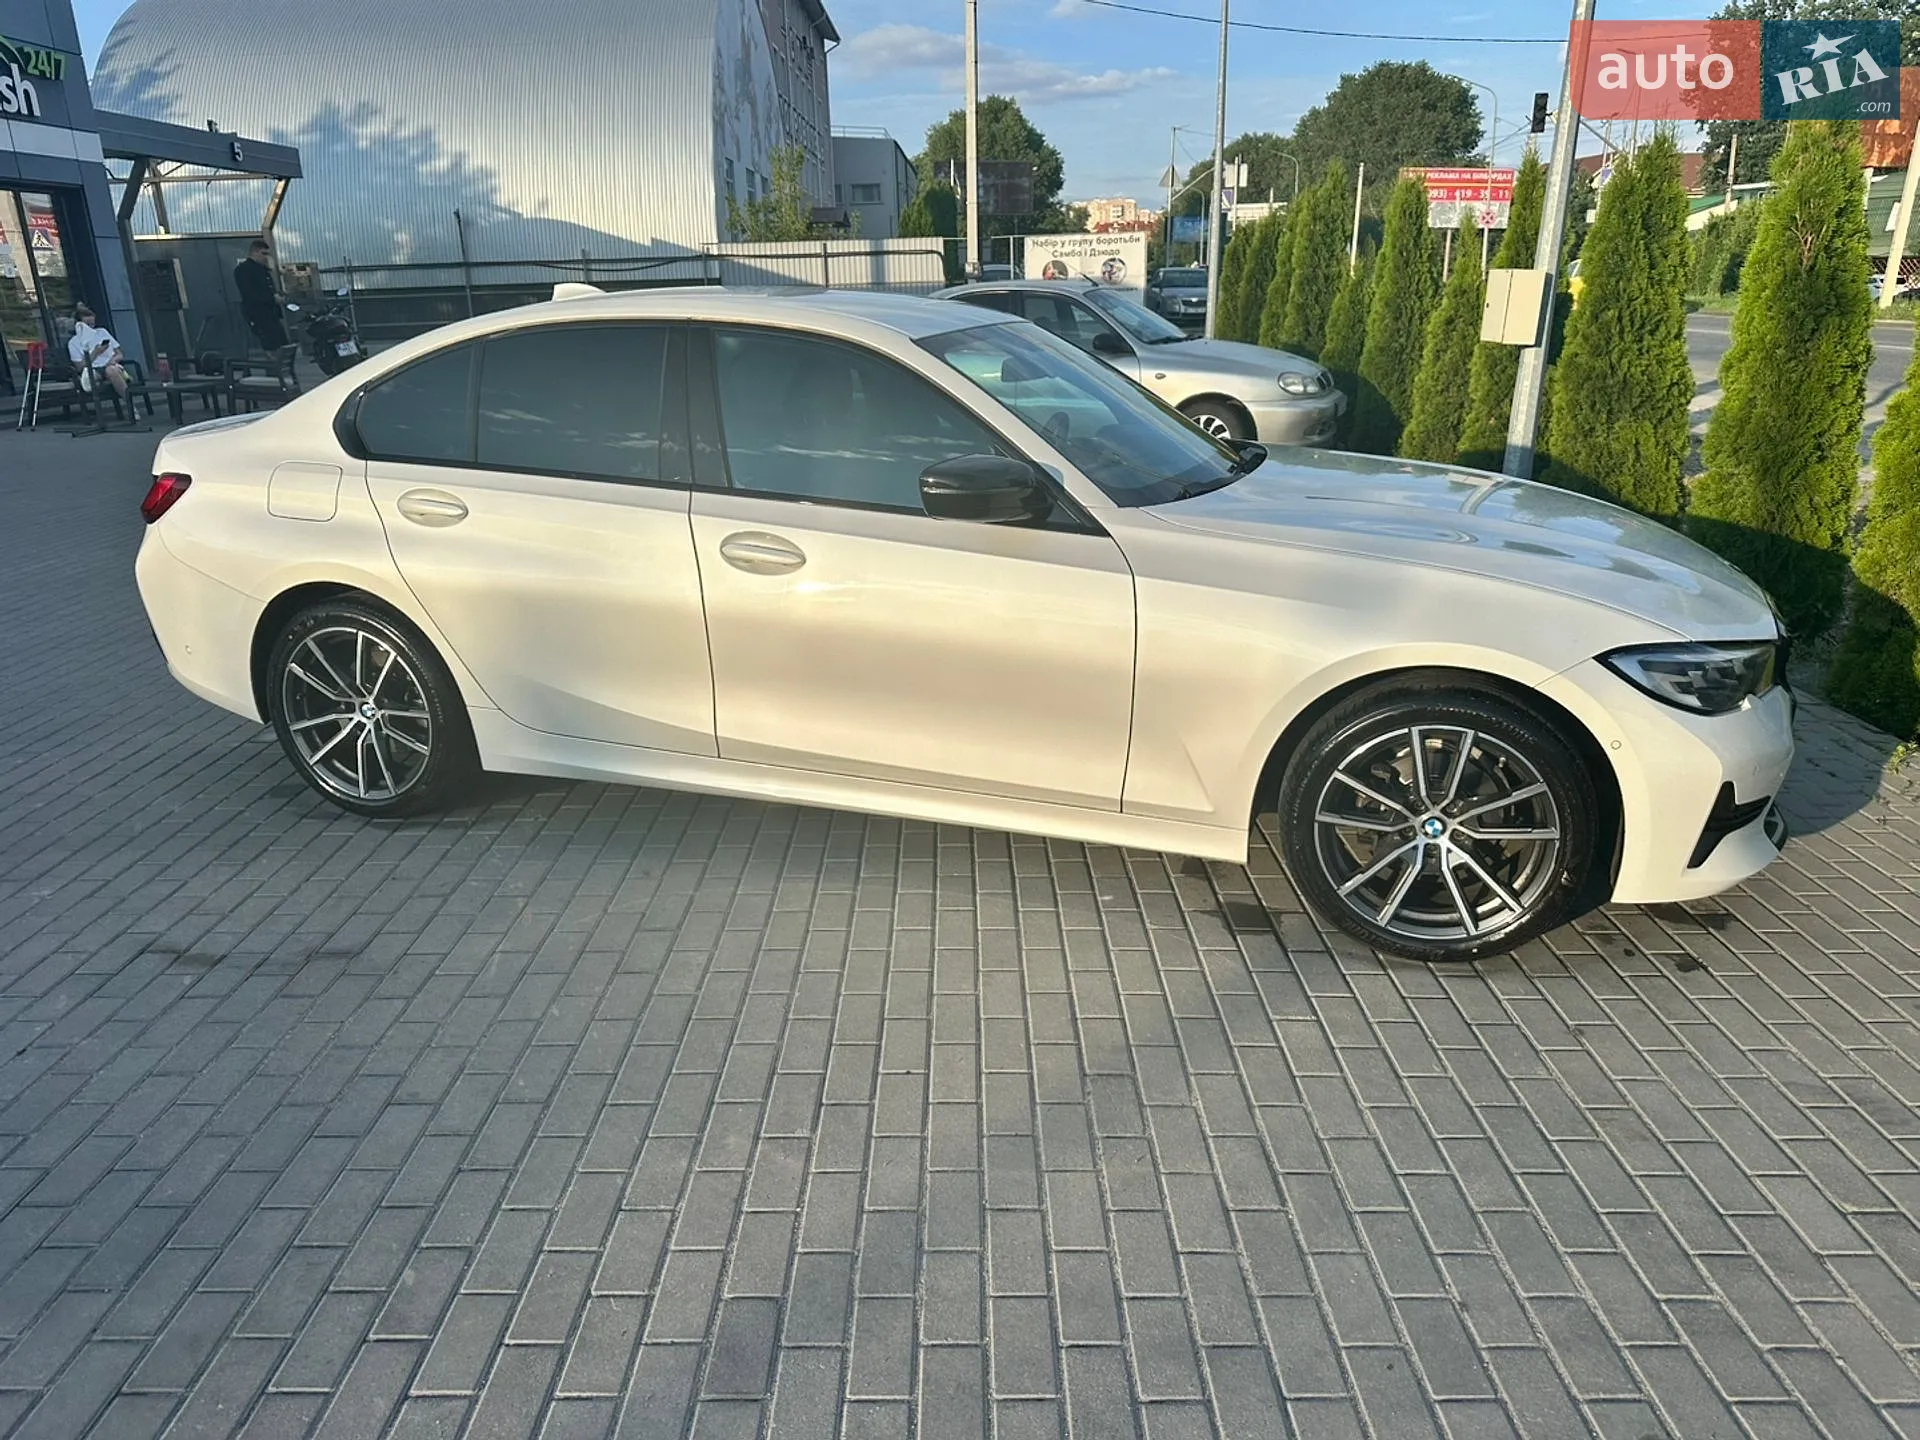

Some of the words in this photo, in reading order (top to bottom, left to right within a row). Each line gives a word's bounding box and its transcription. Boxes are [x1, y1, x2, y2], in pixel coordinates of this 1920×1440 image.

[23, 46, 66, 81] 24/7
[0, 62, 41, 117] sh
[233, 142, 243, 162] 5
[1472, 171, 1512, 180] БІЛБРДАХ
[1499, 188, 1509, 199] 11
[1032, 239, 1058, 248] Набір
[1068, 238, 1093, 247] групу
[1096, 235, 1140, 245] боротьби
[1052, 248, 1082, 258] Самбо
[1089, 248, 1120, 258] Дзюдо
